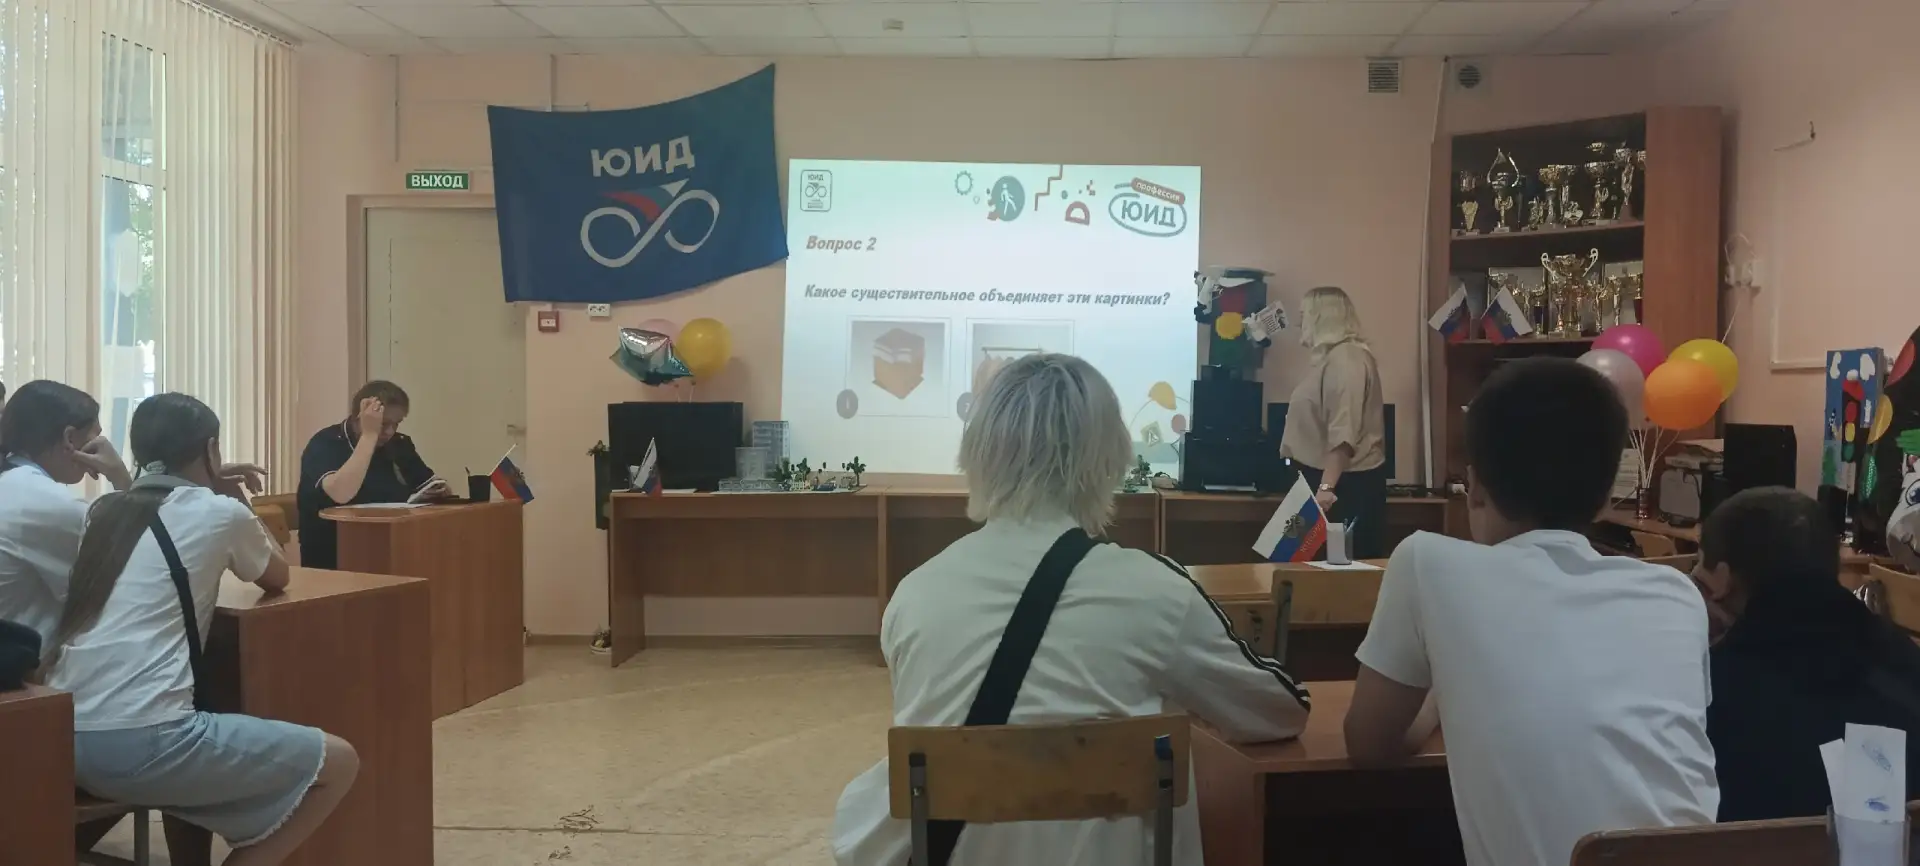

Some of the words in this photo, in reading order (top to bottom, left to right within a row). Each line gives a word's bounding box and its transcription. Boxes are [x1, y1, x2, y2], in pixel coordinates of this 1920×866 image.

[590, 135, 695, 177] ЮИД
[411, 174, 464, 189] ВЫХОД
[1121, 199, 1177, 229] ЮИД
[805, 235, 863, 254] Вопрос
[866, 236, 878, 252] 2
[804, 284, 848, 299] Какое
[851, 287, 976, 302] существительное
[978, 288, 1064, 305] объединяет
[1067, 292, 1092, 304] эти
[1094, 292, 1171, 307] картинки?
